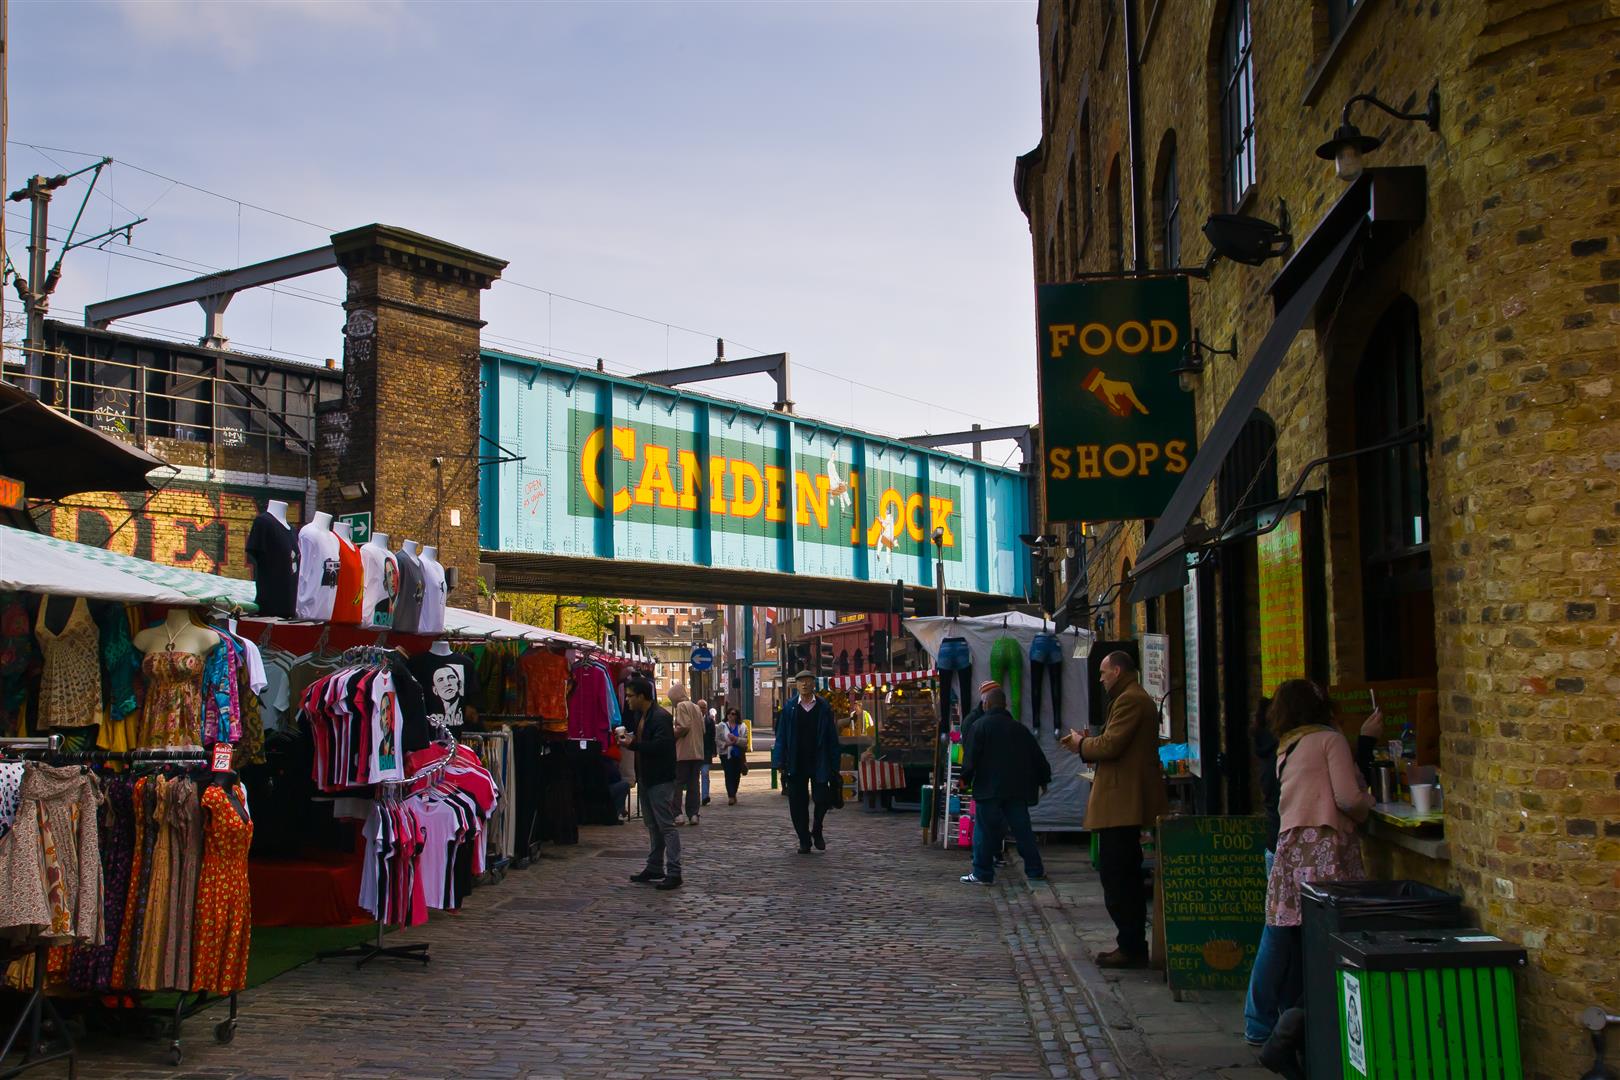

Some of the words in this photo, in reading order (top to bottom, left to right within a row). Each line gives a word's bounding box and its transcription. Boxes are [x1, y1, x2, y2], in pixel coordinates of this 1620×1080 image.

[1048, 319, 1178, 358] FOOD
[1049, 439, 1189, 480] SHOPS
[580, 425, 831, 530] CAMDEN
[849, 470, 955, 548] LOCK
[1212, 833, 1254, 850] FOOD
[1165, 890, 1204, 902] MIXED
[1210, 889, 1264, 902] SEAFOOD
